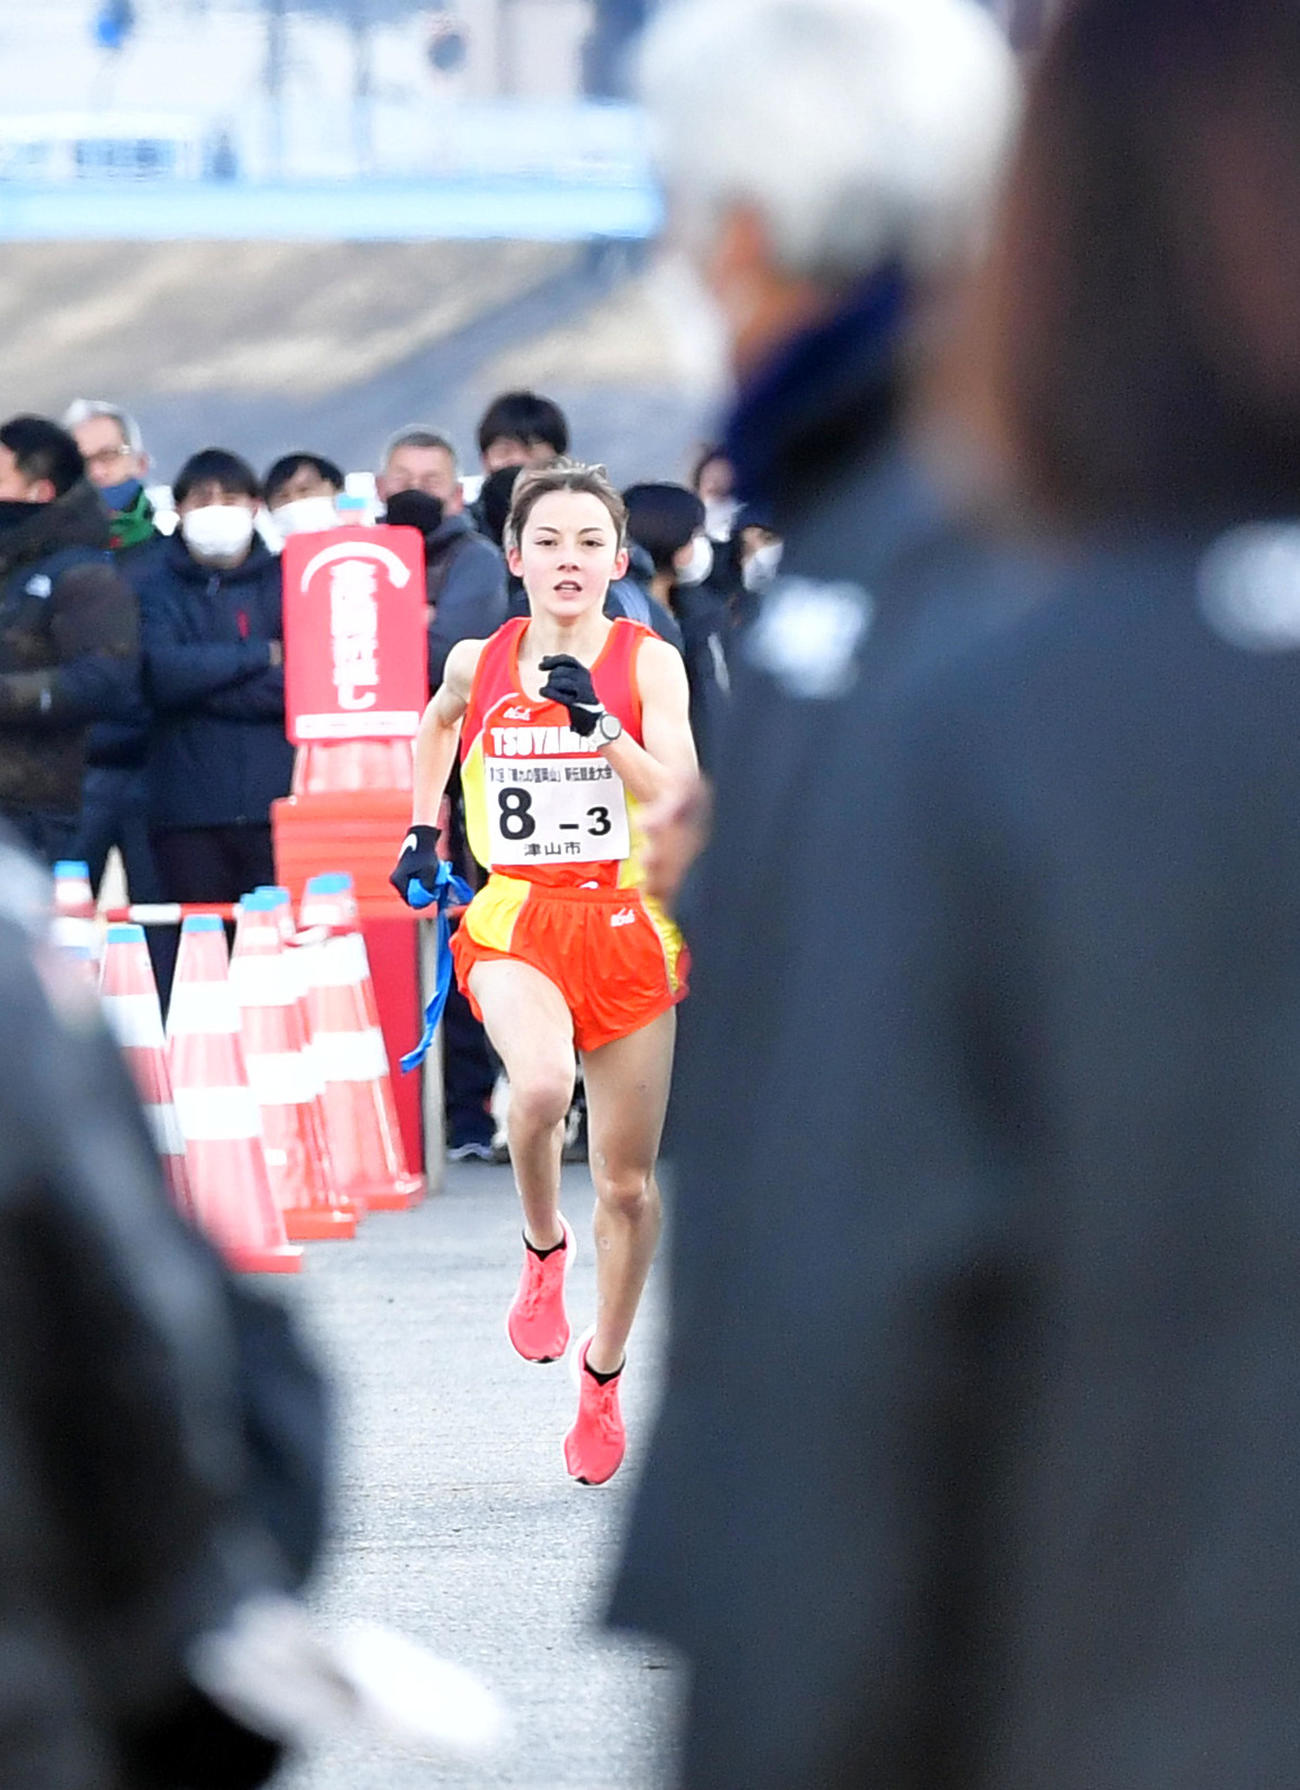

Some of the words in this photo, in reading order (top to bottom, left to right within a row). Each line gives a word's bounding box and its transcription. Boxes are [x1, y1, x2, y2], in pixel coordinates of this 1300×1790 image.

[498, 787, 536, 840] 8
[524, 841, 581, 857] 津山市
